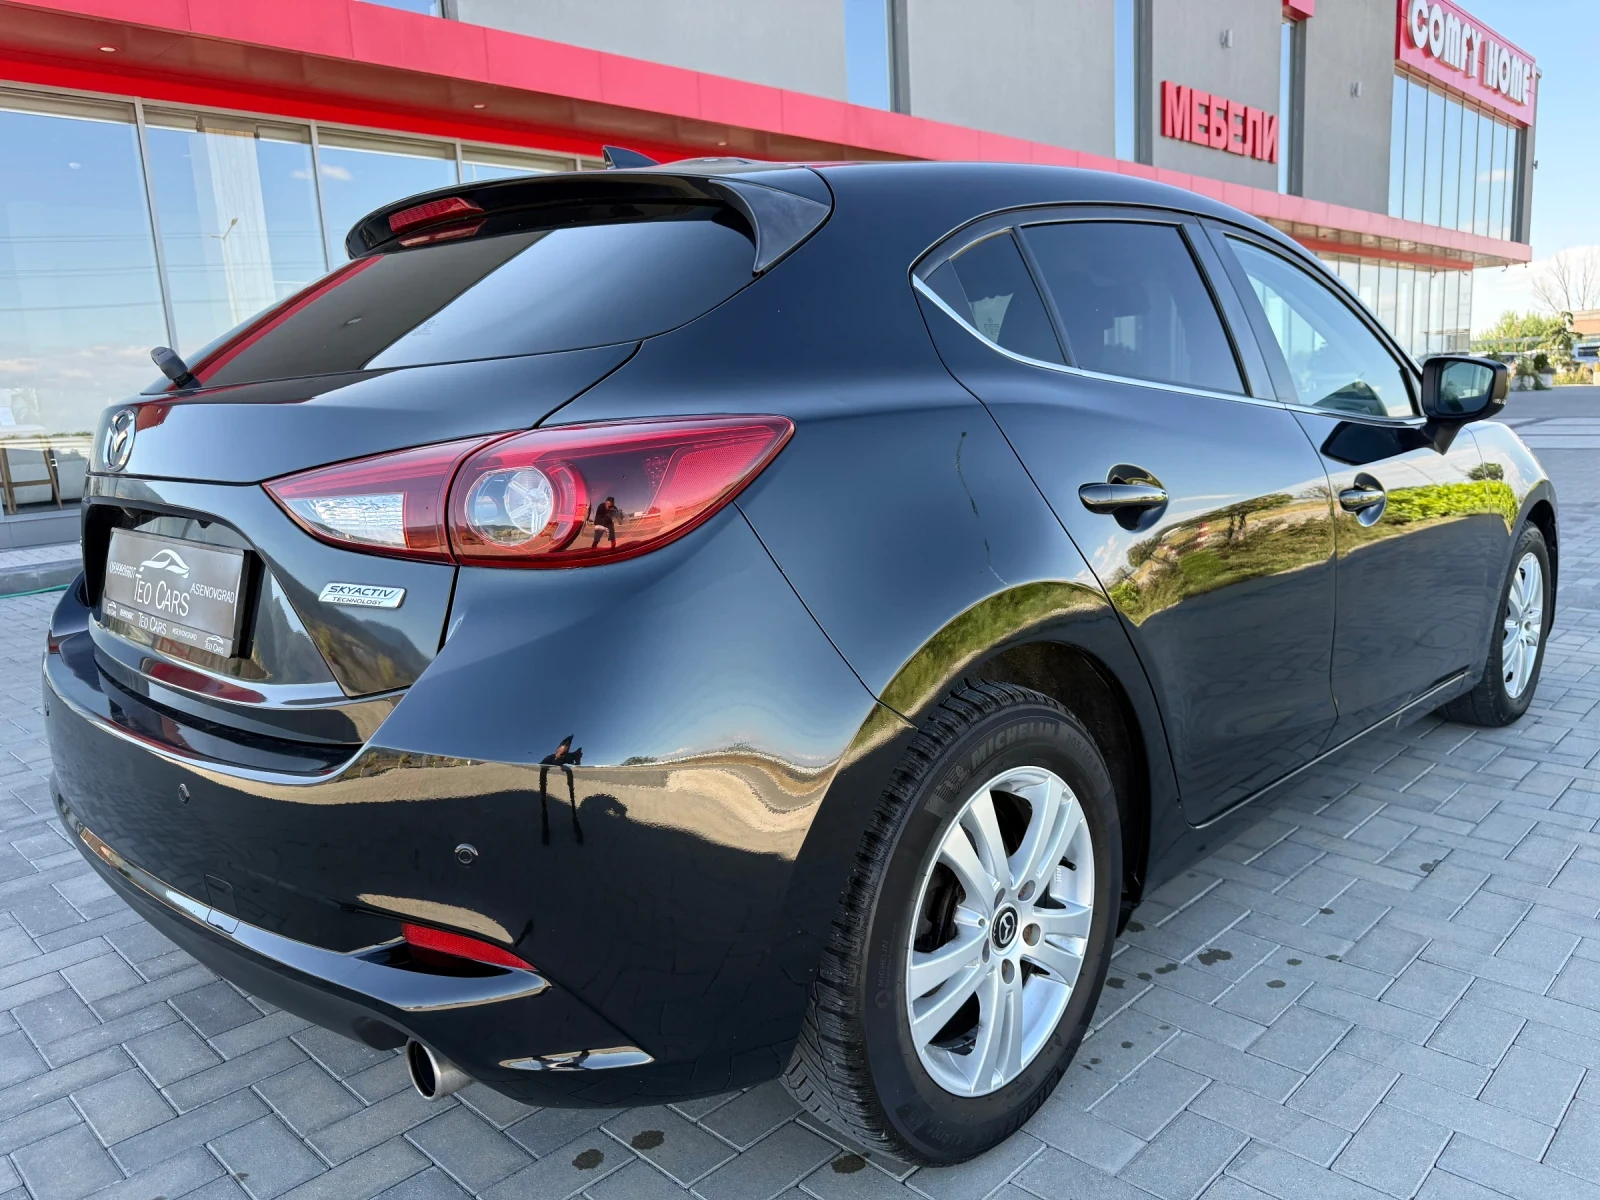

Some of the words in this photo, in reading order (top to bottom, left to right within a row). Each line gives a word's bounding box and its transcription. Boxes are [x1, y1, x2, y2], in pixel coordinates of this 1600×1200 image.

[1407, 0, 1482, 78] COMFY
[1484, 40, 1529, 106] HOME
[1161, 80, 1279, 164] МЕБЕЛИ
[190, 582, 235, 604] ASENOVGRAD
[328, 585, 394, 598] SKYACTIV
[332, 597, 384, 606] TECHNOLOGY
[970, 721, 1056, 771] MICHELIN
